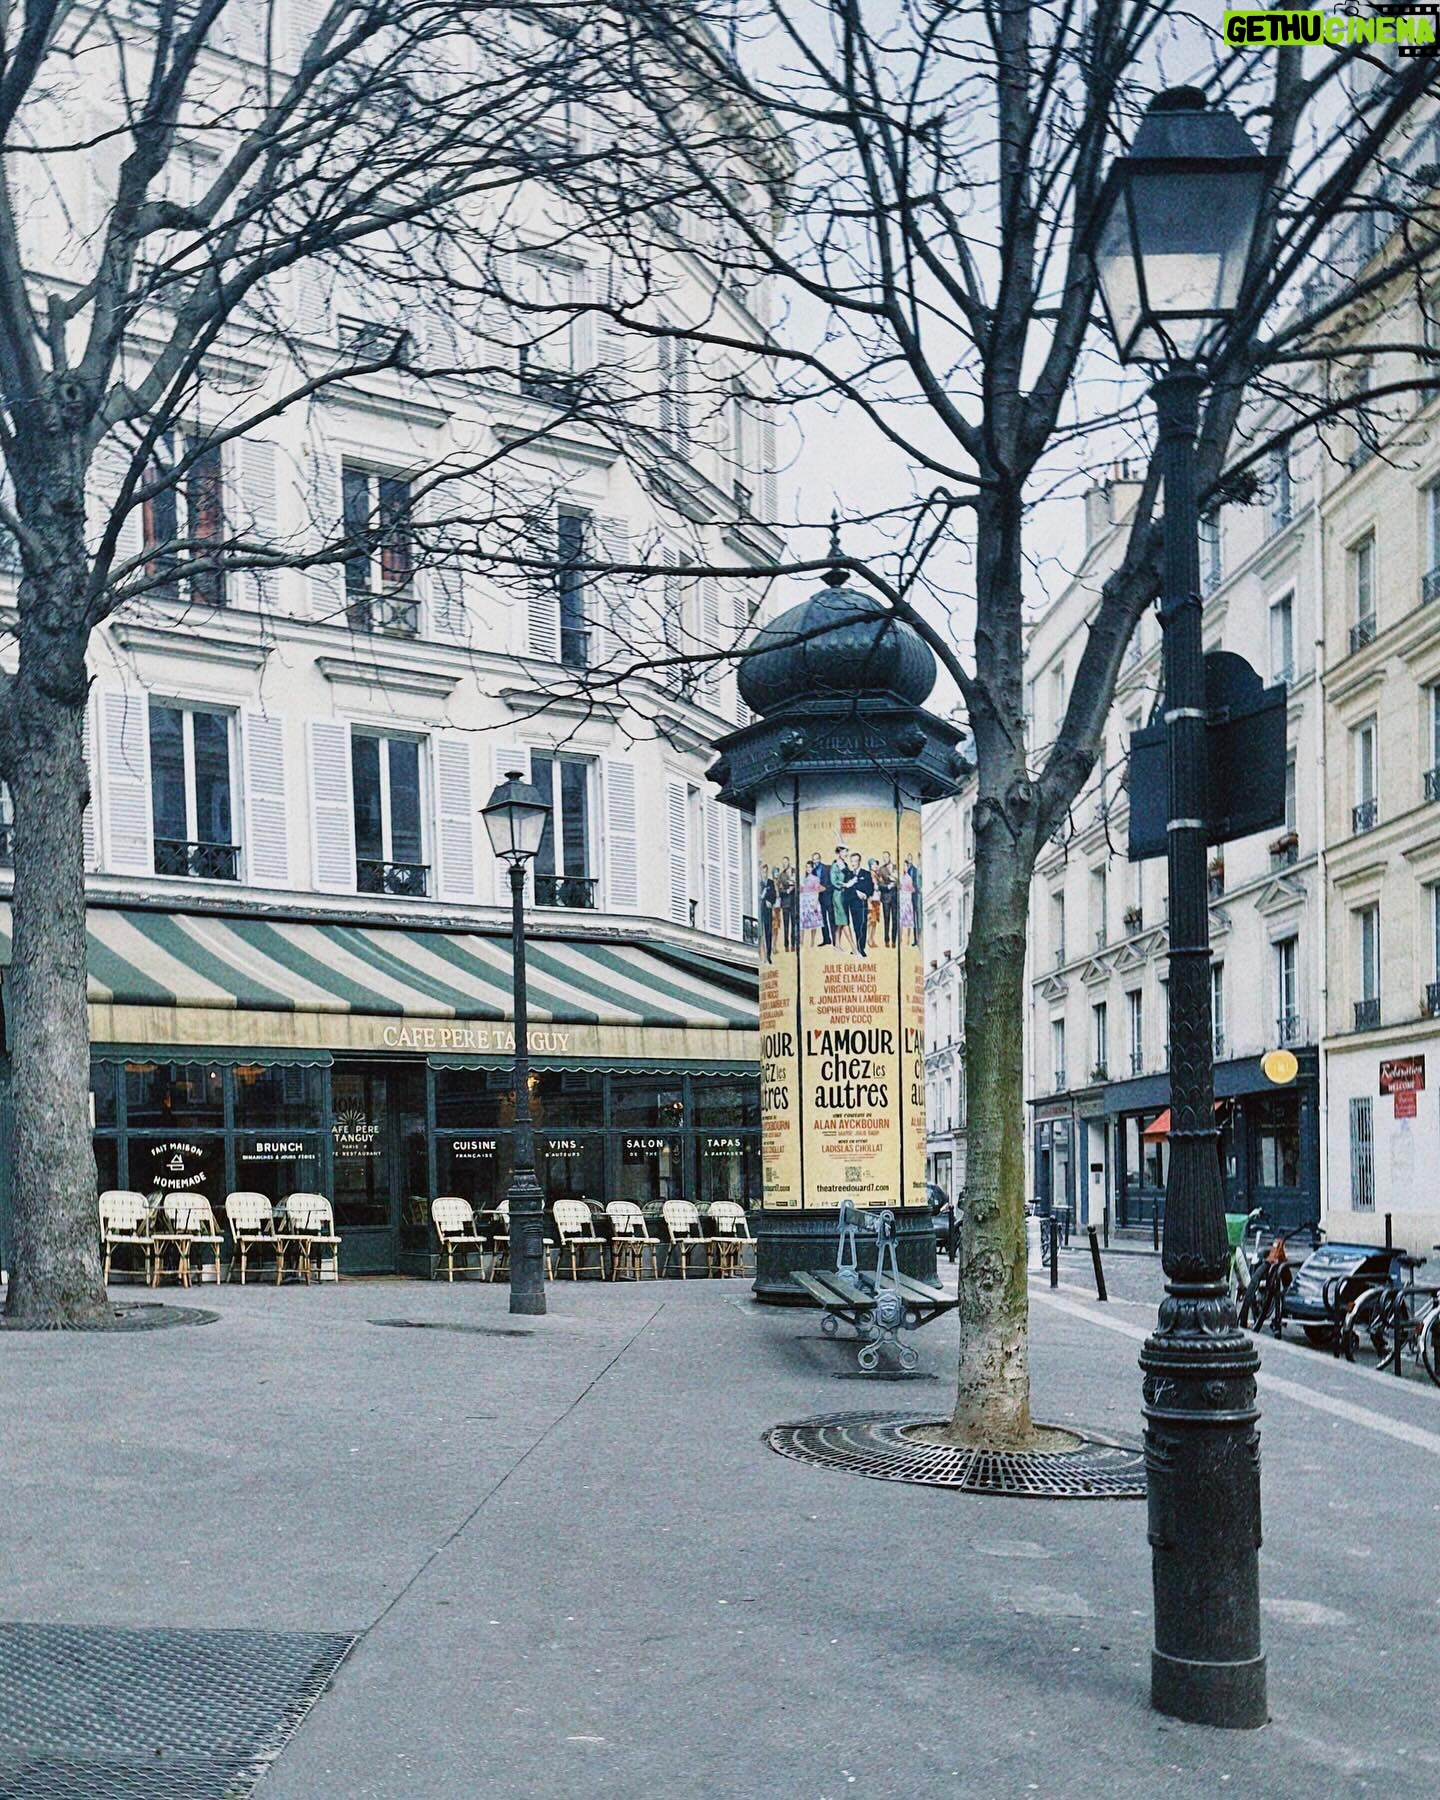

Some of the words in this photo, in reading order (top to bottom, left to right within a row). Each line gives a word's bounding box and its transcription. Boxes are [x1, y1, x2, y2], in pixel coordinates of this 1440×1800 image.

[822, 964, 843, 974] JULIE
[823, 985, 855, 994] VIRGINIE
[817, 994, 857, 1004] JONATHAN
[859, 994, 890, 1003] LAMBERT
[817, 1006, 843, 1014] SOPHIE
[830, 1015, 850, 1024] ANDY
[383, 1026, 436, 1048] CAFE
[440, 1028, 489, 1049] PERE
[821, 1054, 871, 1082] chez
[872, 1062, 886, 1079] les
[815, 1080, 888, 1109] autres
[814, 1119, 837, 1130] ALAN
[838, 1118, 890, 1129] AYCKBOURN
[331, 1125, 349, 1134] AFE
[334, 1134, 374, 1142] TANGUY
[707, 1138, 741, 1148] TAPAS
[256, 1142, 303, 1152] BRUNCH
[453, 1141, 496, 1150] CUISINE
[626, 1139, 664, 1148] SALON
[821, 1144, 853, 1153] LADISLAS
[854, 1143, 883, 1152] CHOLLAT
[151, 1143, 167, 1156] FAIT
[170, 1142, 203, 1157] MAISON
[153, 1170, 207, 1190] HOMEMADE
[816, 1183, 890, 1193] theatreedouard7.com
